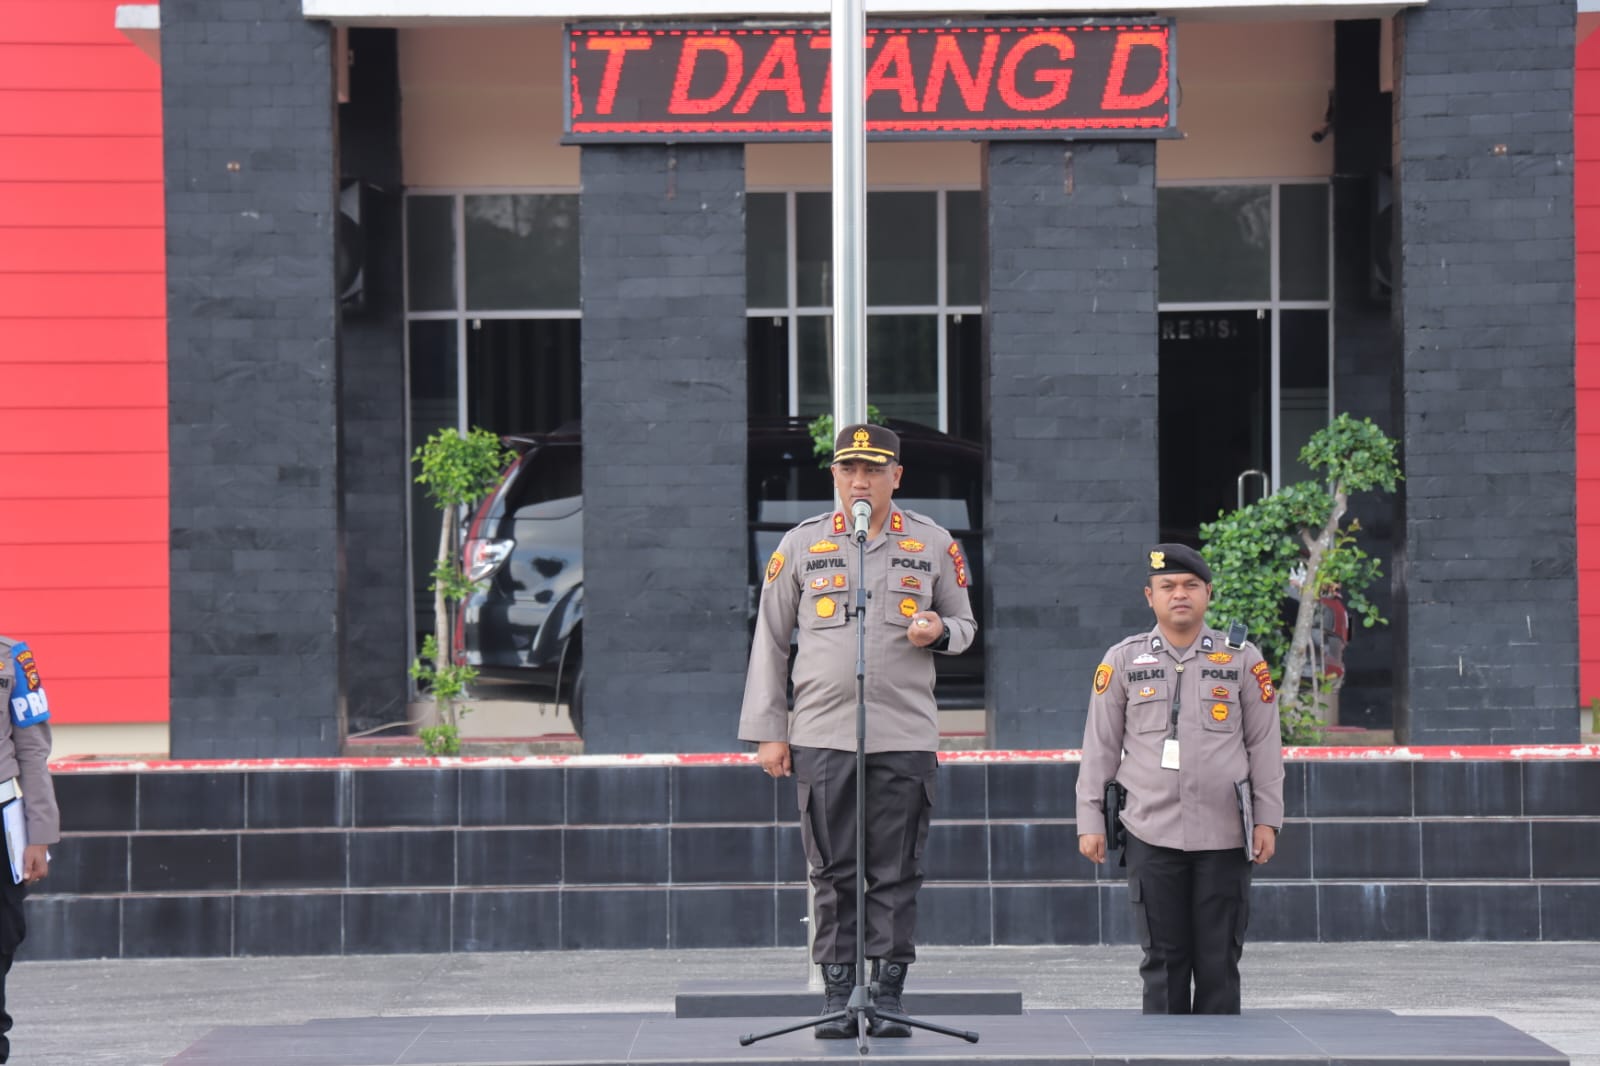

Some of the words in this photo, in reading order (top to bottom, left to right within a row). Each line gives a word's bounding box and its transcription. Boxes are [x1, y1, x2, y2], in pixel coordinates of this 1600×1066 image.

[572, 36, 653, 115] T
[1100, 32, 1166, 110] D
[806, 559, 828, 571] ANDI
[828, 557, 847, 568] YUL
[891, 557, 932, 572] POLRI
[1127, 668, 1165, 683] HELKI
[1201, 668, 1239, 681] POLRI
